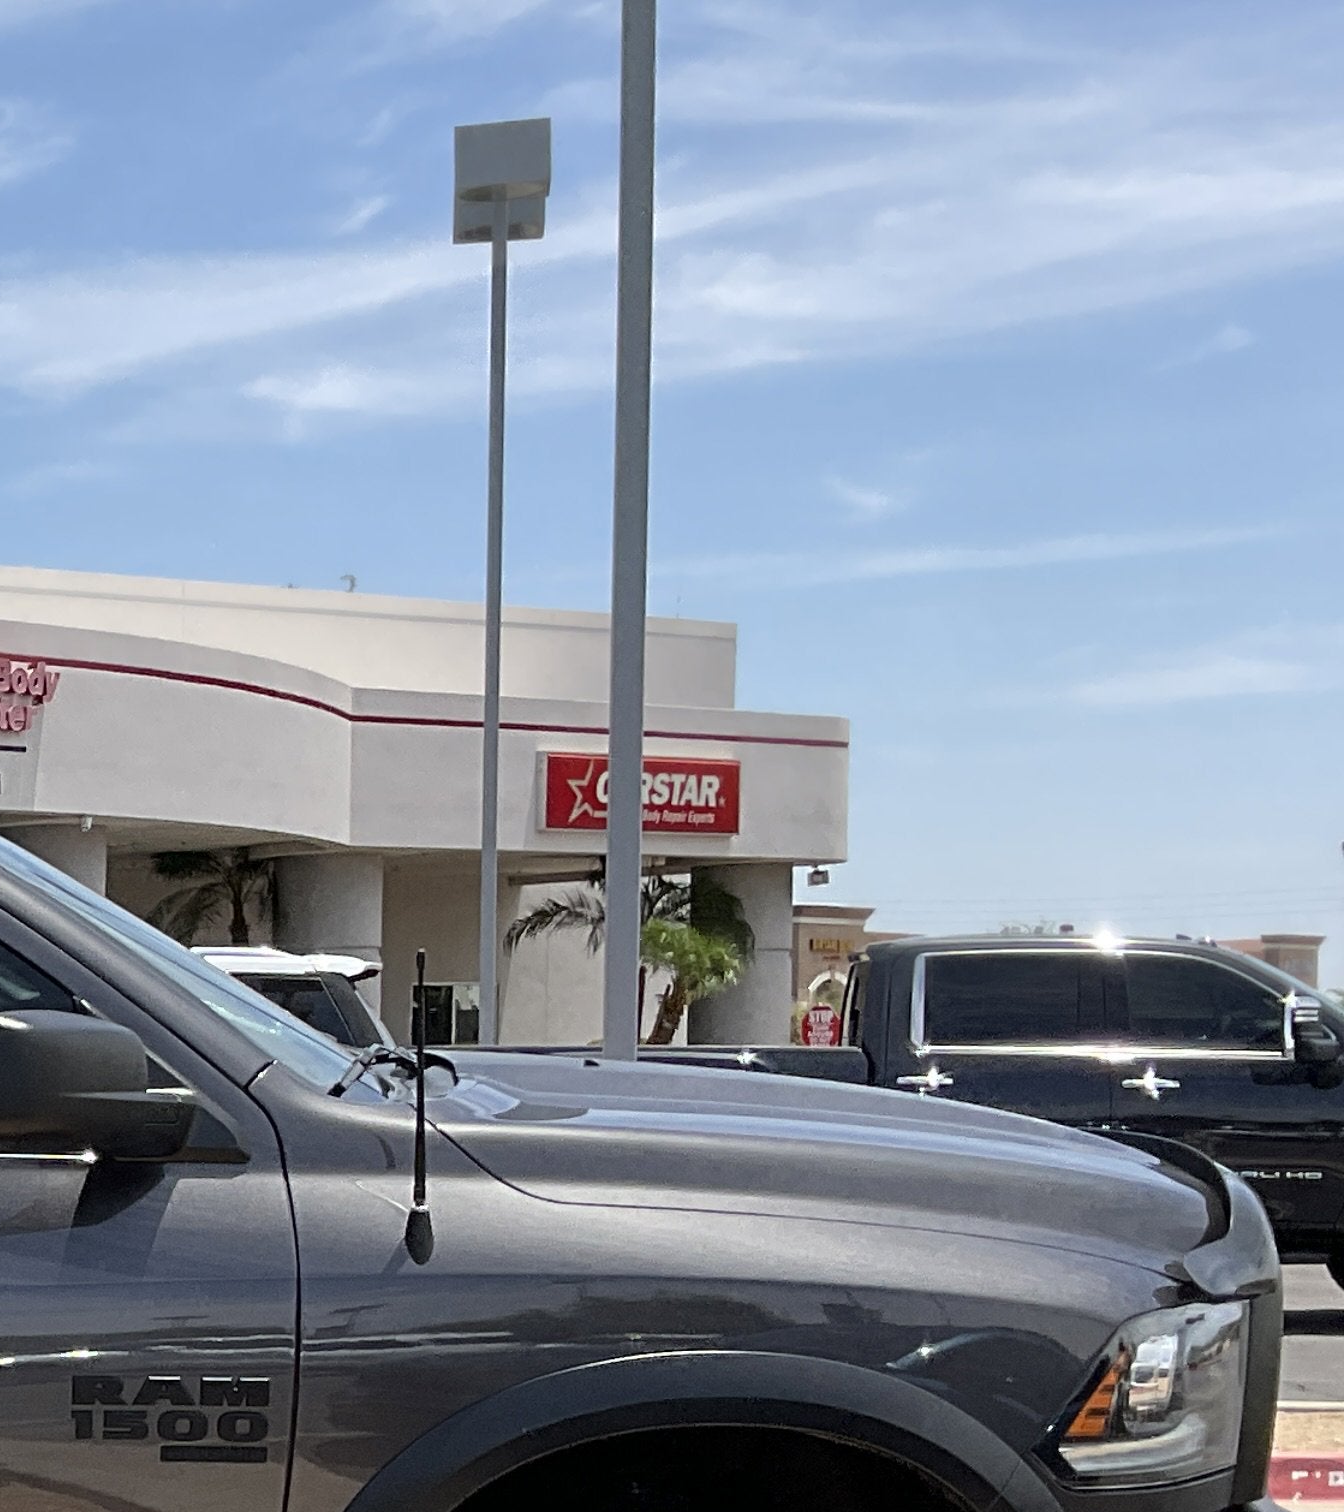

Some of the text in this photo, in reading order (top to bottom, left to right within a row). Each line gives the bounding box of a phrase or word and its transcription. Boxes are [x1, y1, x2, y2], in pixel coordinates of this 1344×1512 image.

[596, 770, 720, 808] CRSTAR
[70, 1374, 272, 1407] RAM
[70, 1409, 269, 1443] 1500
